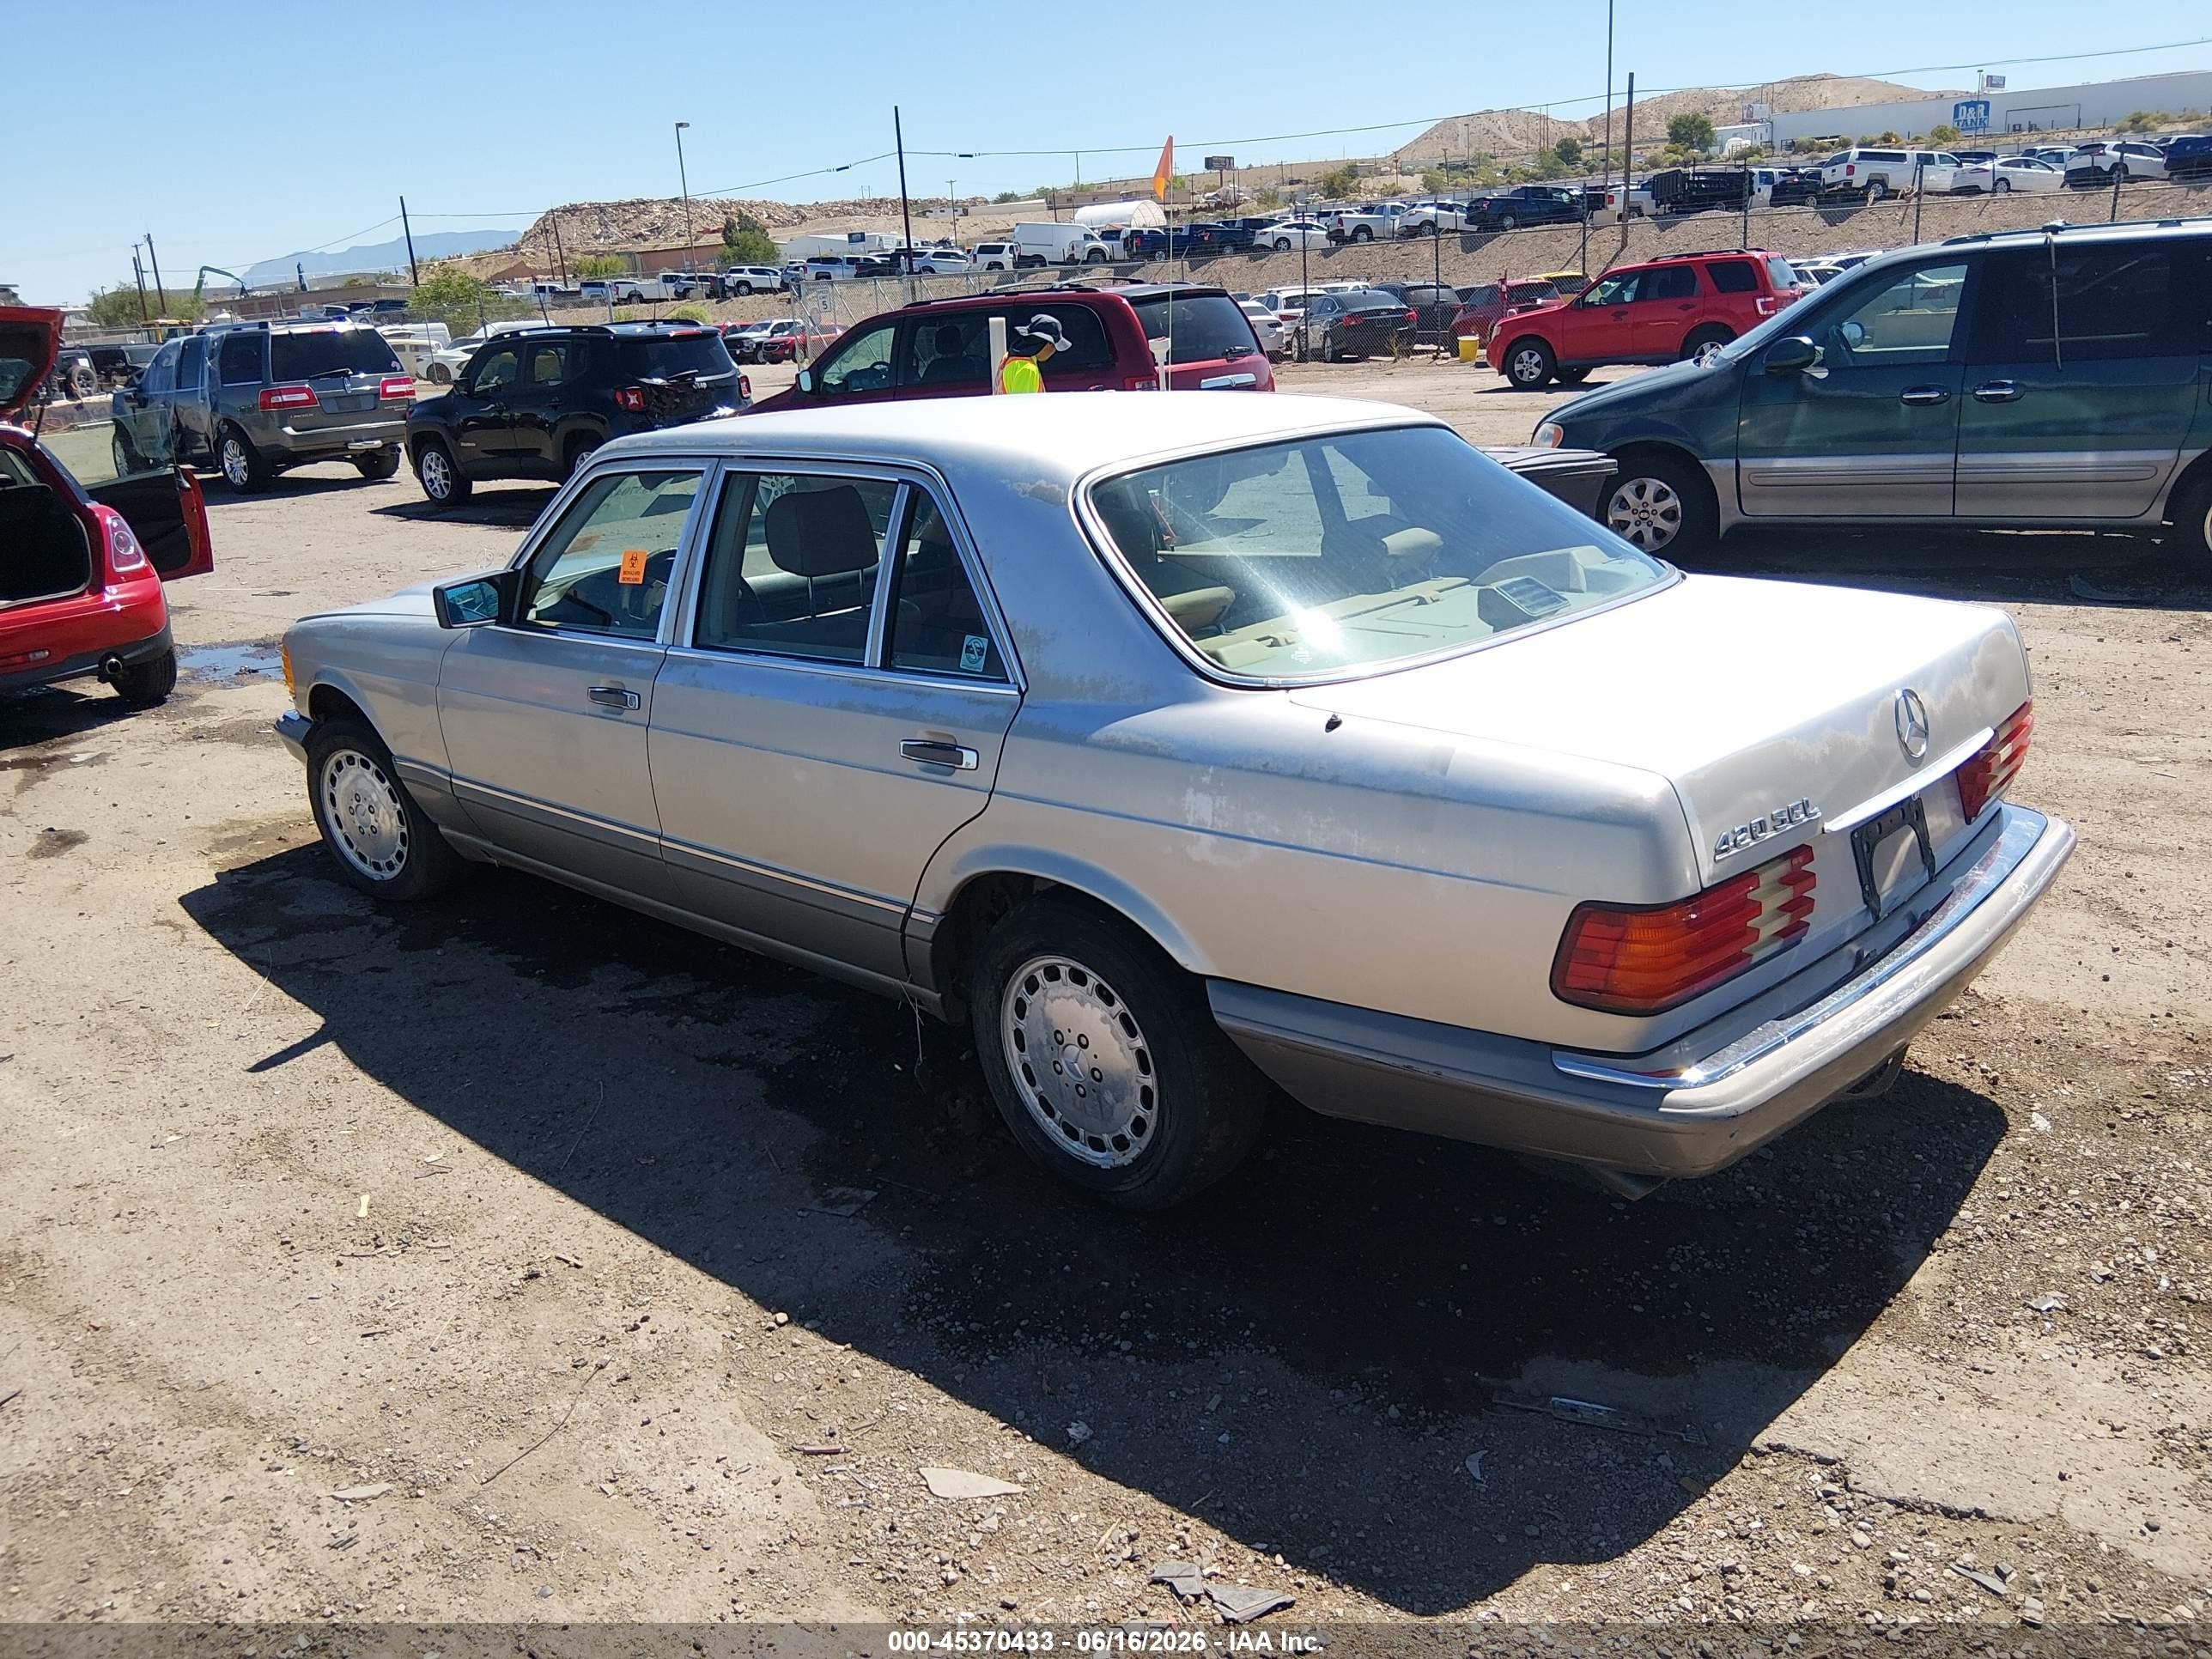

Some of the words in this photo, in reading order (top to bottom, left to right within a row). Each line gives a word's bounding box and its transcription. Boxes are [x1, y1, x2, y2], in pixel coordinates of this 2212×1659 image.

[1954, 117, 1987, 127] TANK
[822, 301, 828, 310] 5
[1715, 817, 1767, 853] 420
[1771, 798, 1820, 830] SEL
